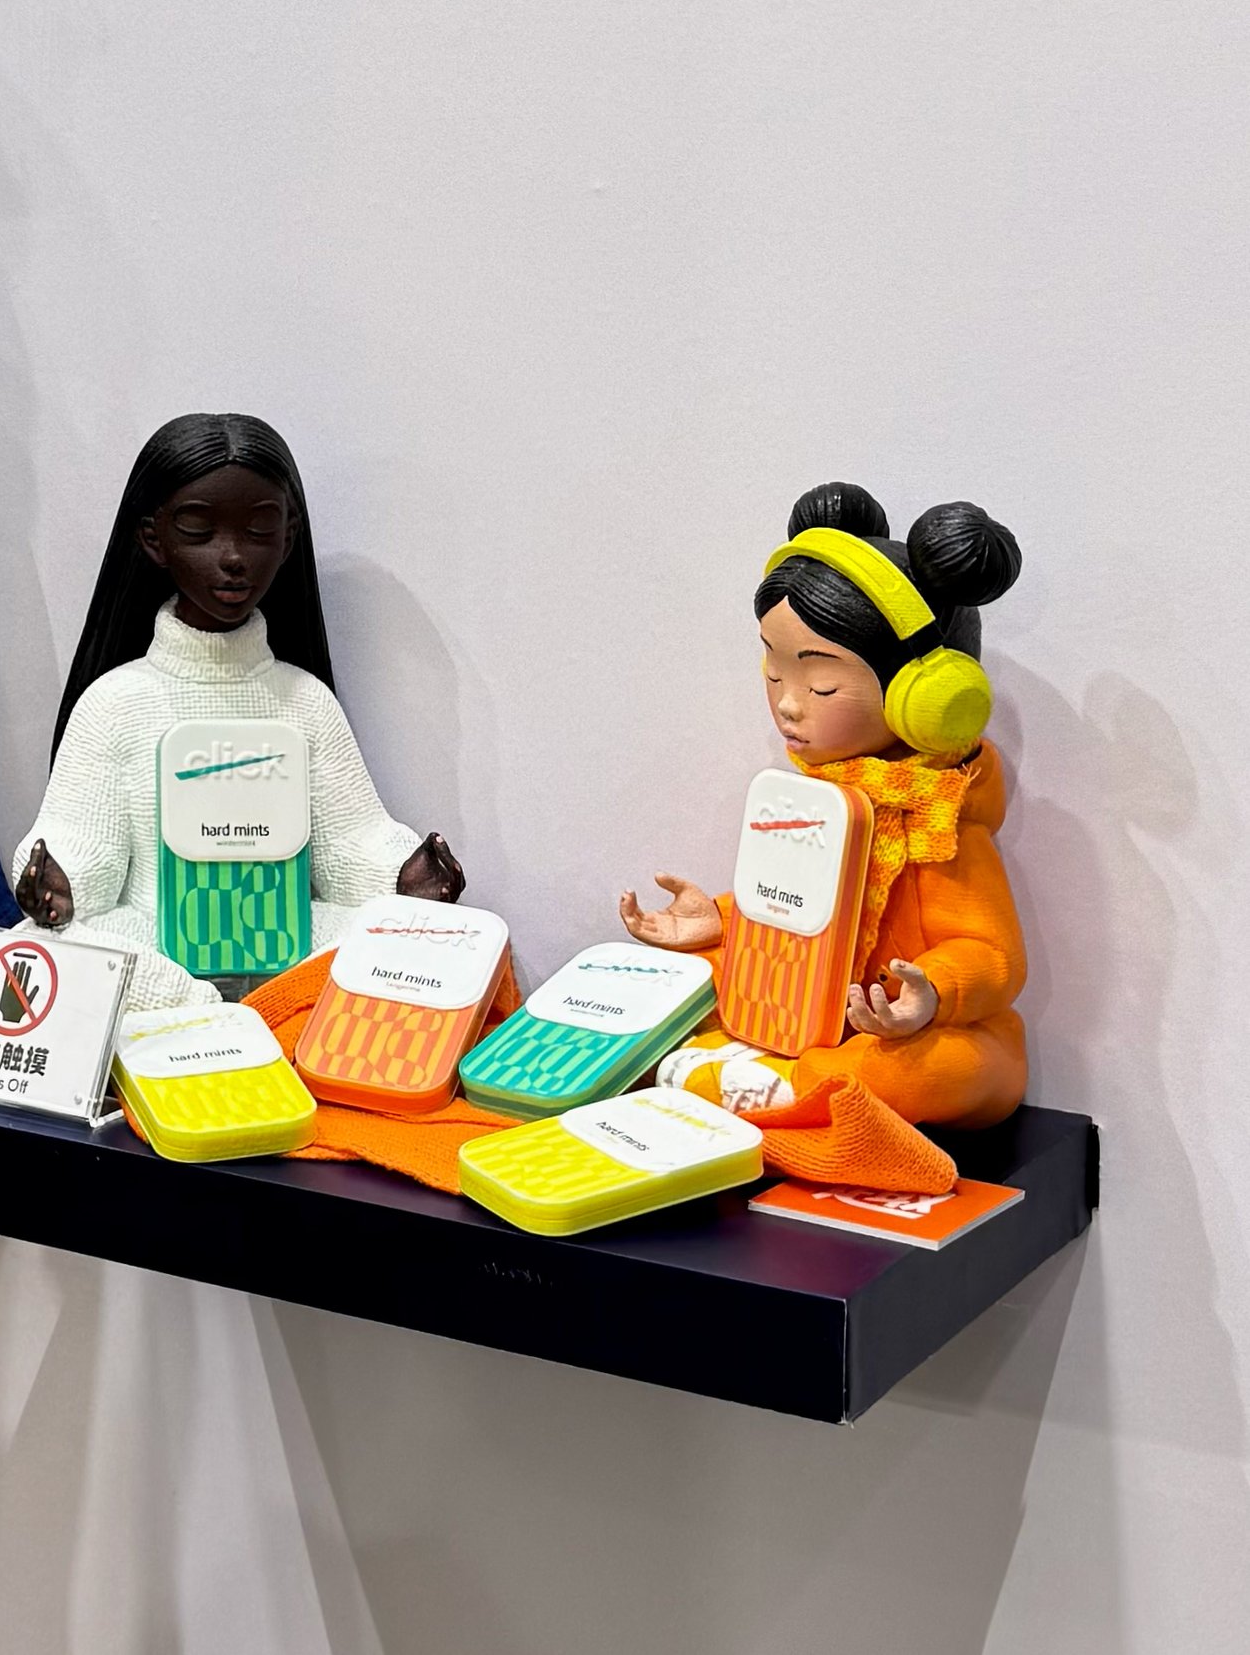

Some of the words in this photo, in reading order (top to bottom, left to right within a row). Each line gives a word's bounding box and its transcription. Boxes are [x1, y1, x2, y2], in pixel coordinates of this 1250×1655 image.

[201, 822, 230, 837] hard
[233, 822, 270, 837] mints
[756, 881, 778, 900] hard
[371, 965, 403, 981] hard
[405, 974, 442, 989] mints
[169, 1052, 201, 1063] hard
[204, 1047, 242, 1059] mints
[7, 1077, 29, 1094] Off
